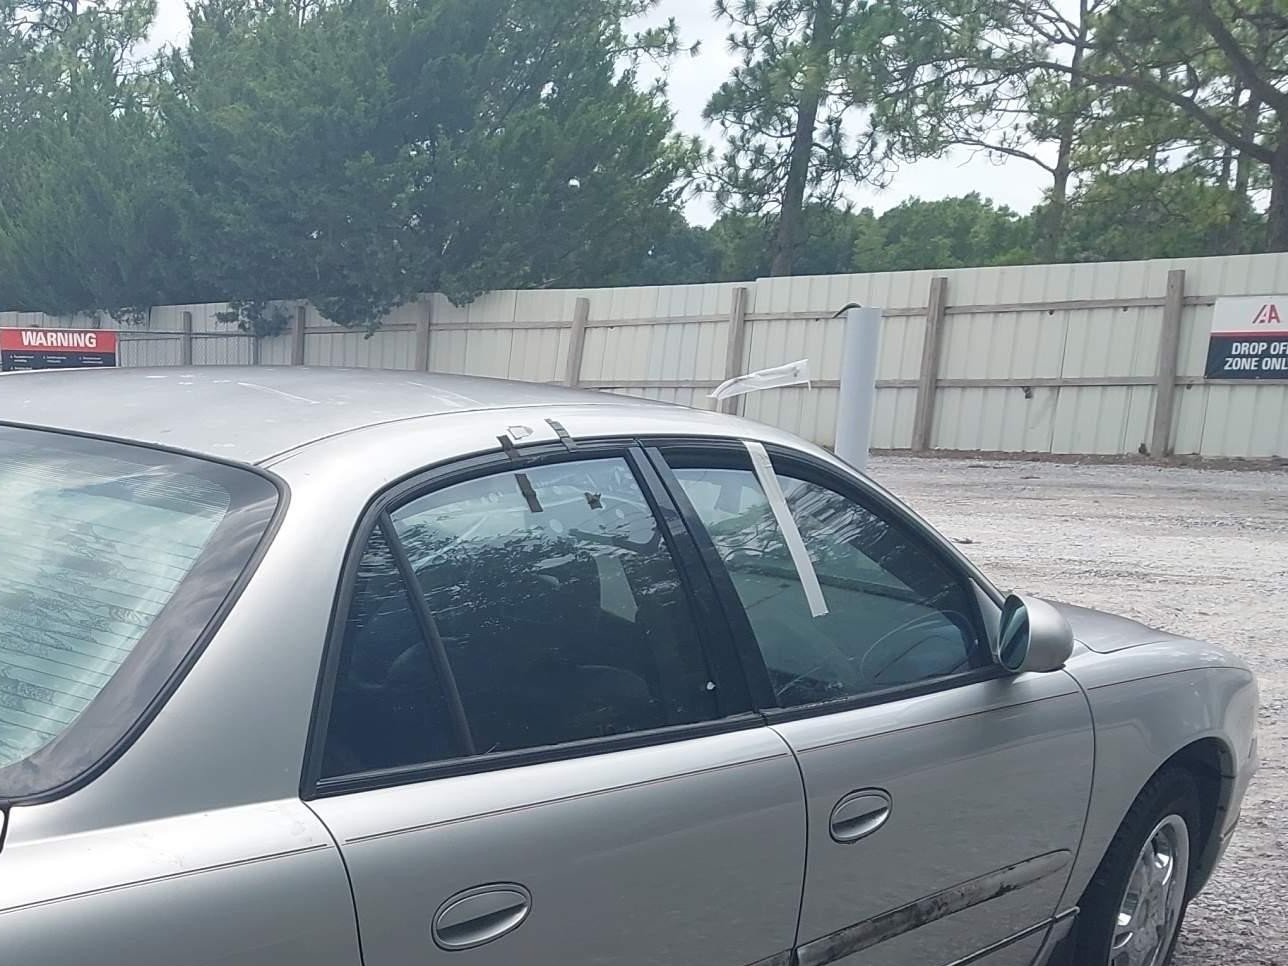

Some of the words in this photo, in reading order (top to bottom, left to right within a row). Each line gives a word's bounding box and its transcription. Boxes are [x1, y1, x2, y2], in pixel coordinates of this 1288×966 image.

[21, 331, 97, 348] WARNING
[1231, 342, 1267, 355] DROP
[1270, 342, 1288, 355] OF
[1224, 357, 1259, 370] ZONE
